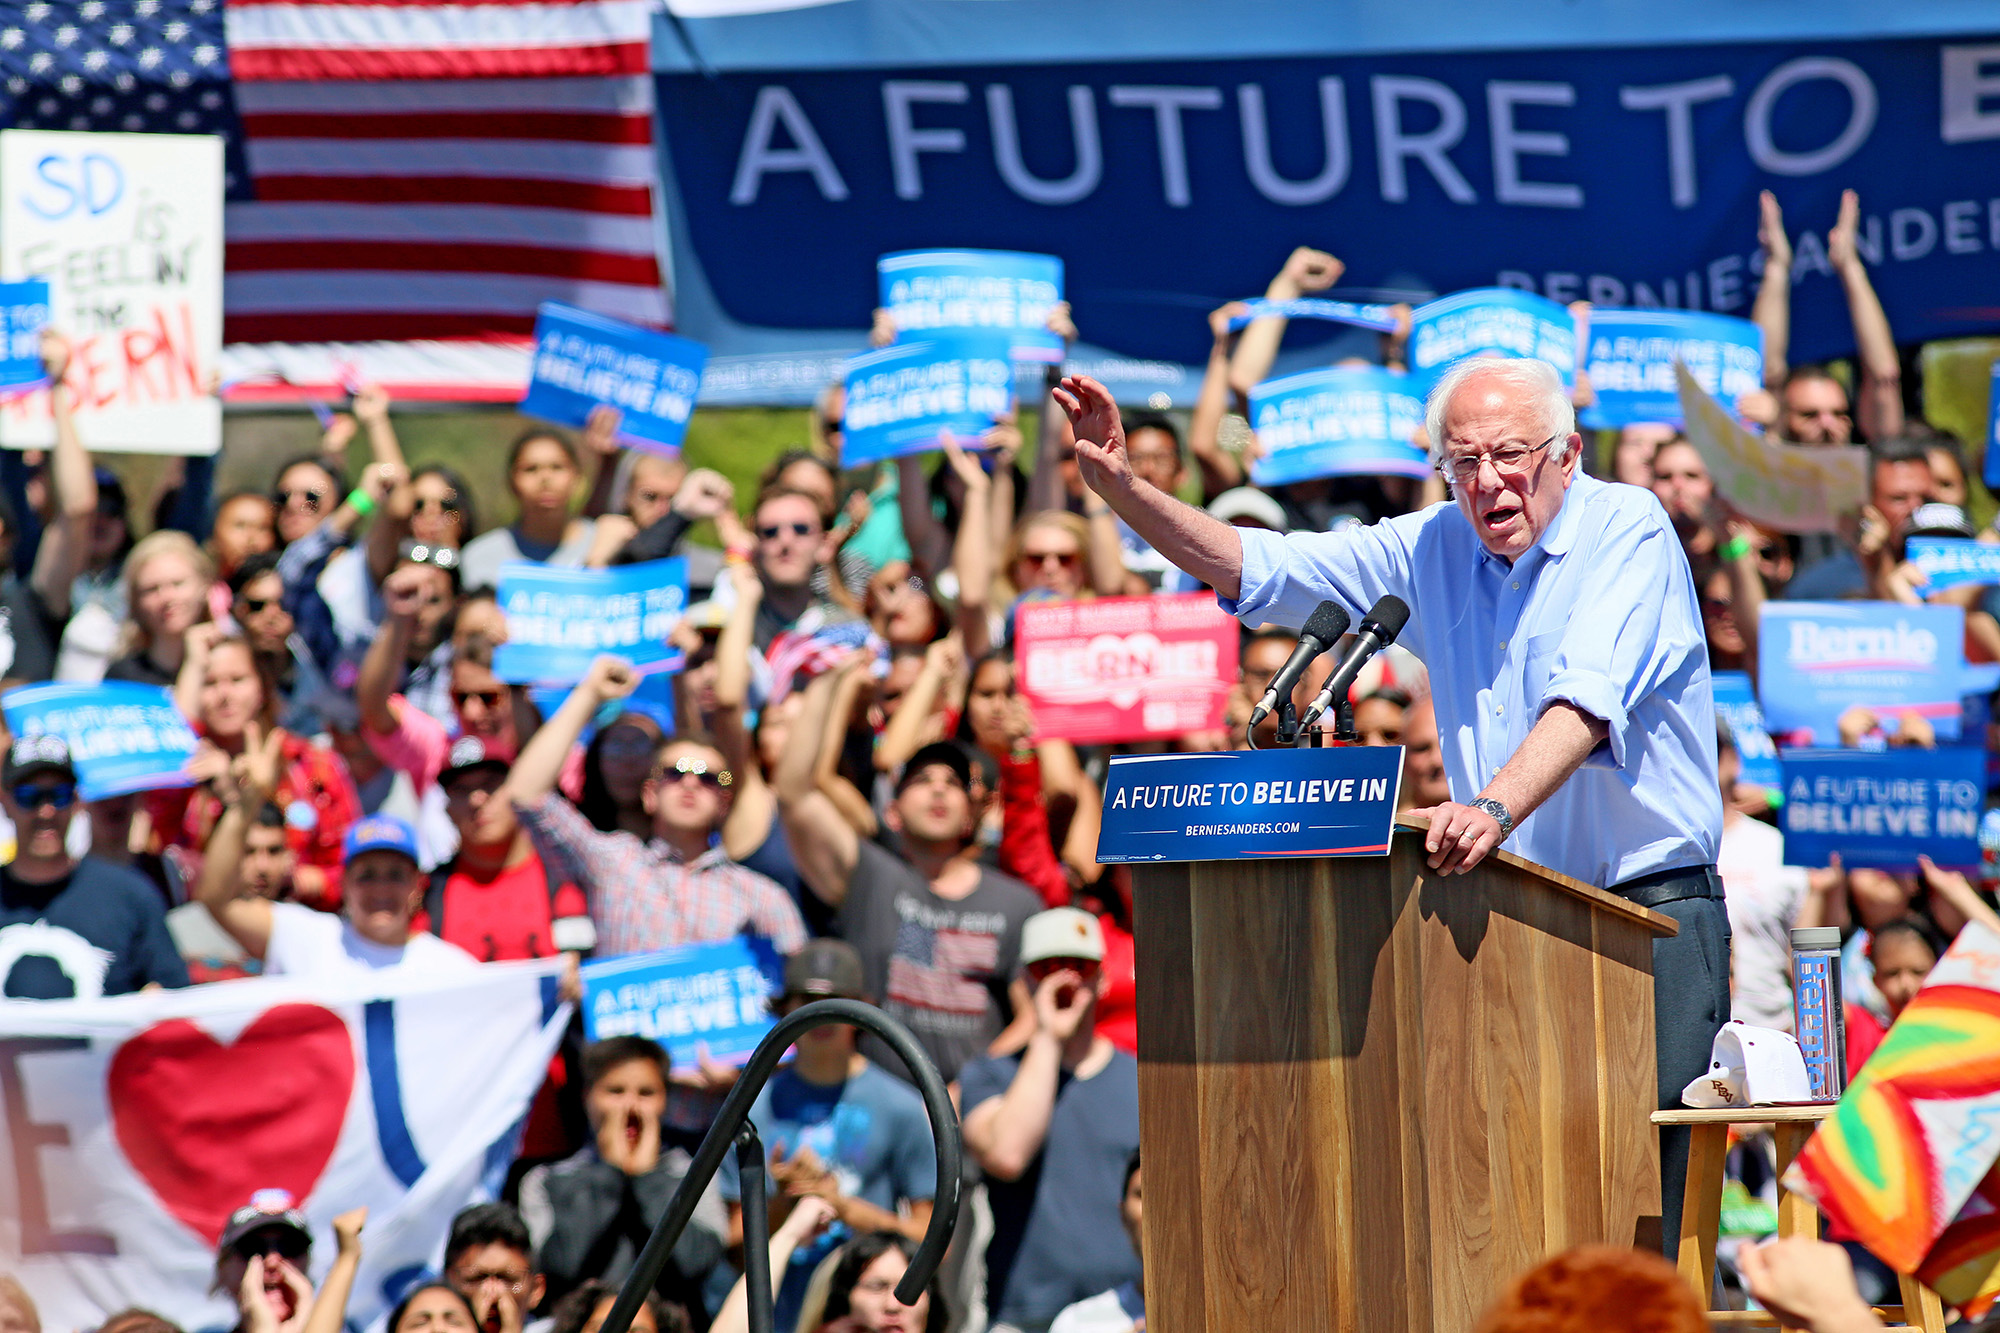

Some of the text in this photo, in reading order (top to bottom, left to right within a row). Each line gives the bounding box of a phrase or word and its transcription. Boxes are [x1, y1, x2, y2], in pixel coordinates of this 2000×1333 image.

[730, 85, 850, 207] A
[881, 74, 1585, 209] FUTURE
[1619, 55, 1879, 209] TO
[21, 154, 125, 220] SD
[1788, 619, 1938, 664] Bernie
[1112, 778, 1388, 809] A FUTURE TO BELIEVE IN
[1789, 776, 1979, 807] A FUTURE TO
[1185, 822, 1300, 836] BERNIESANDERS.COM
[1787, 802, 1979, 838] BELIEVE IN
[1799, 954, 1832, 1090] Bernie
